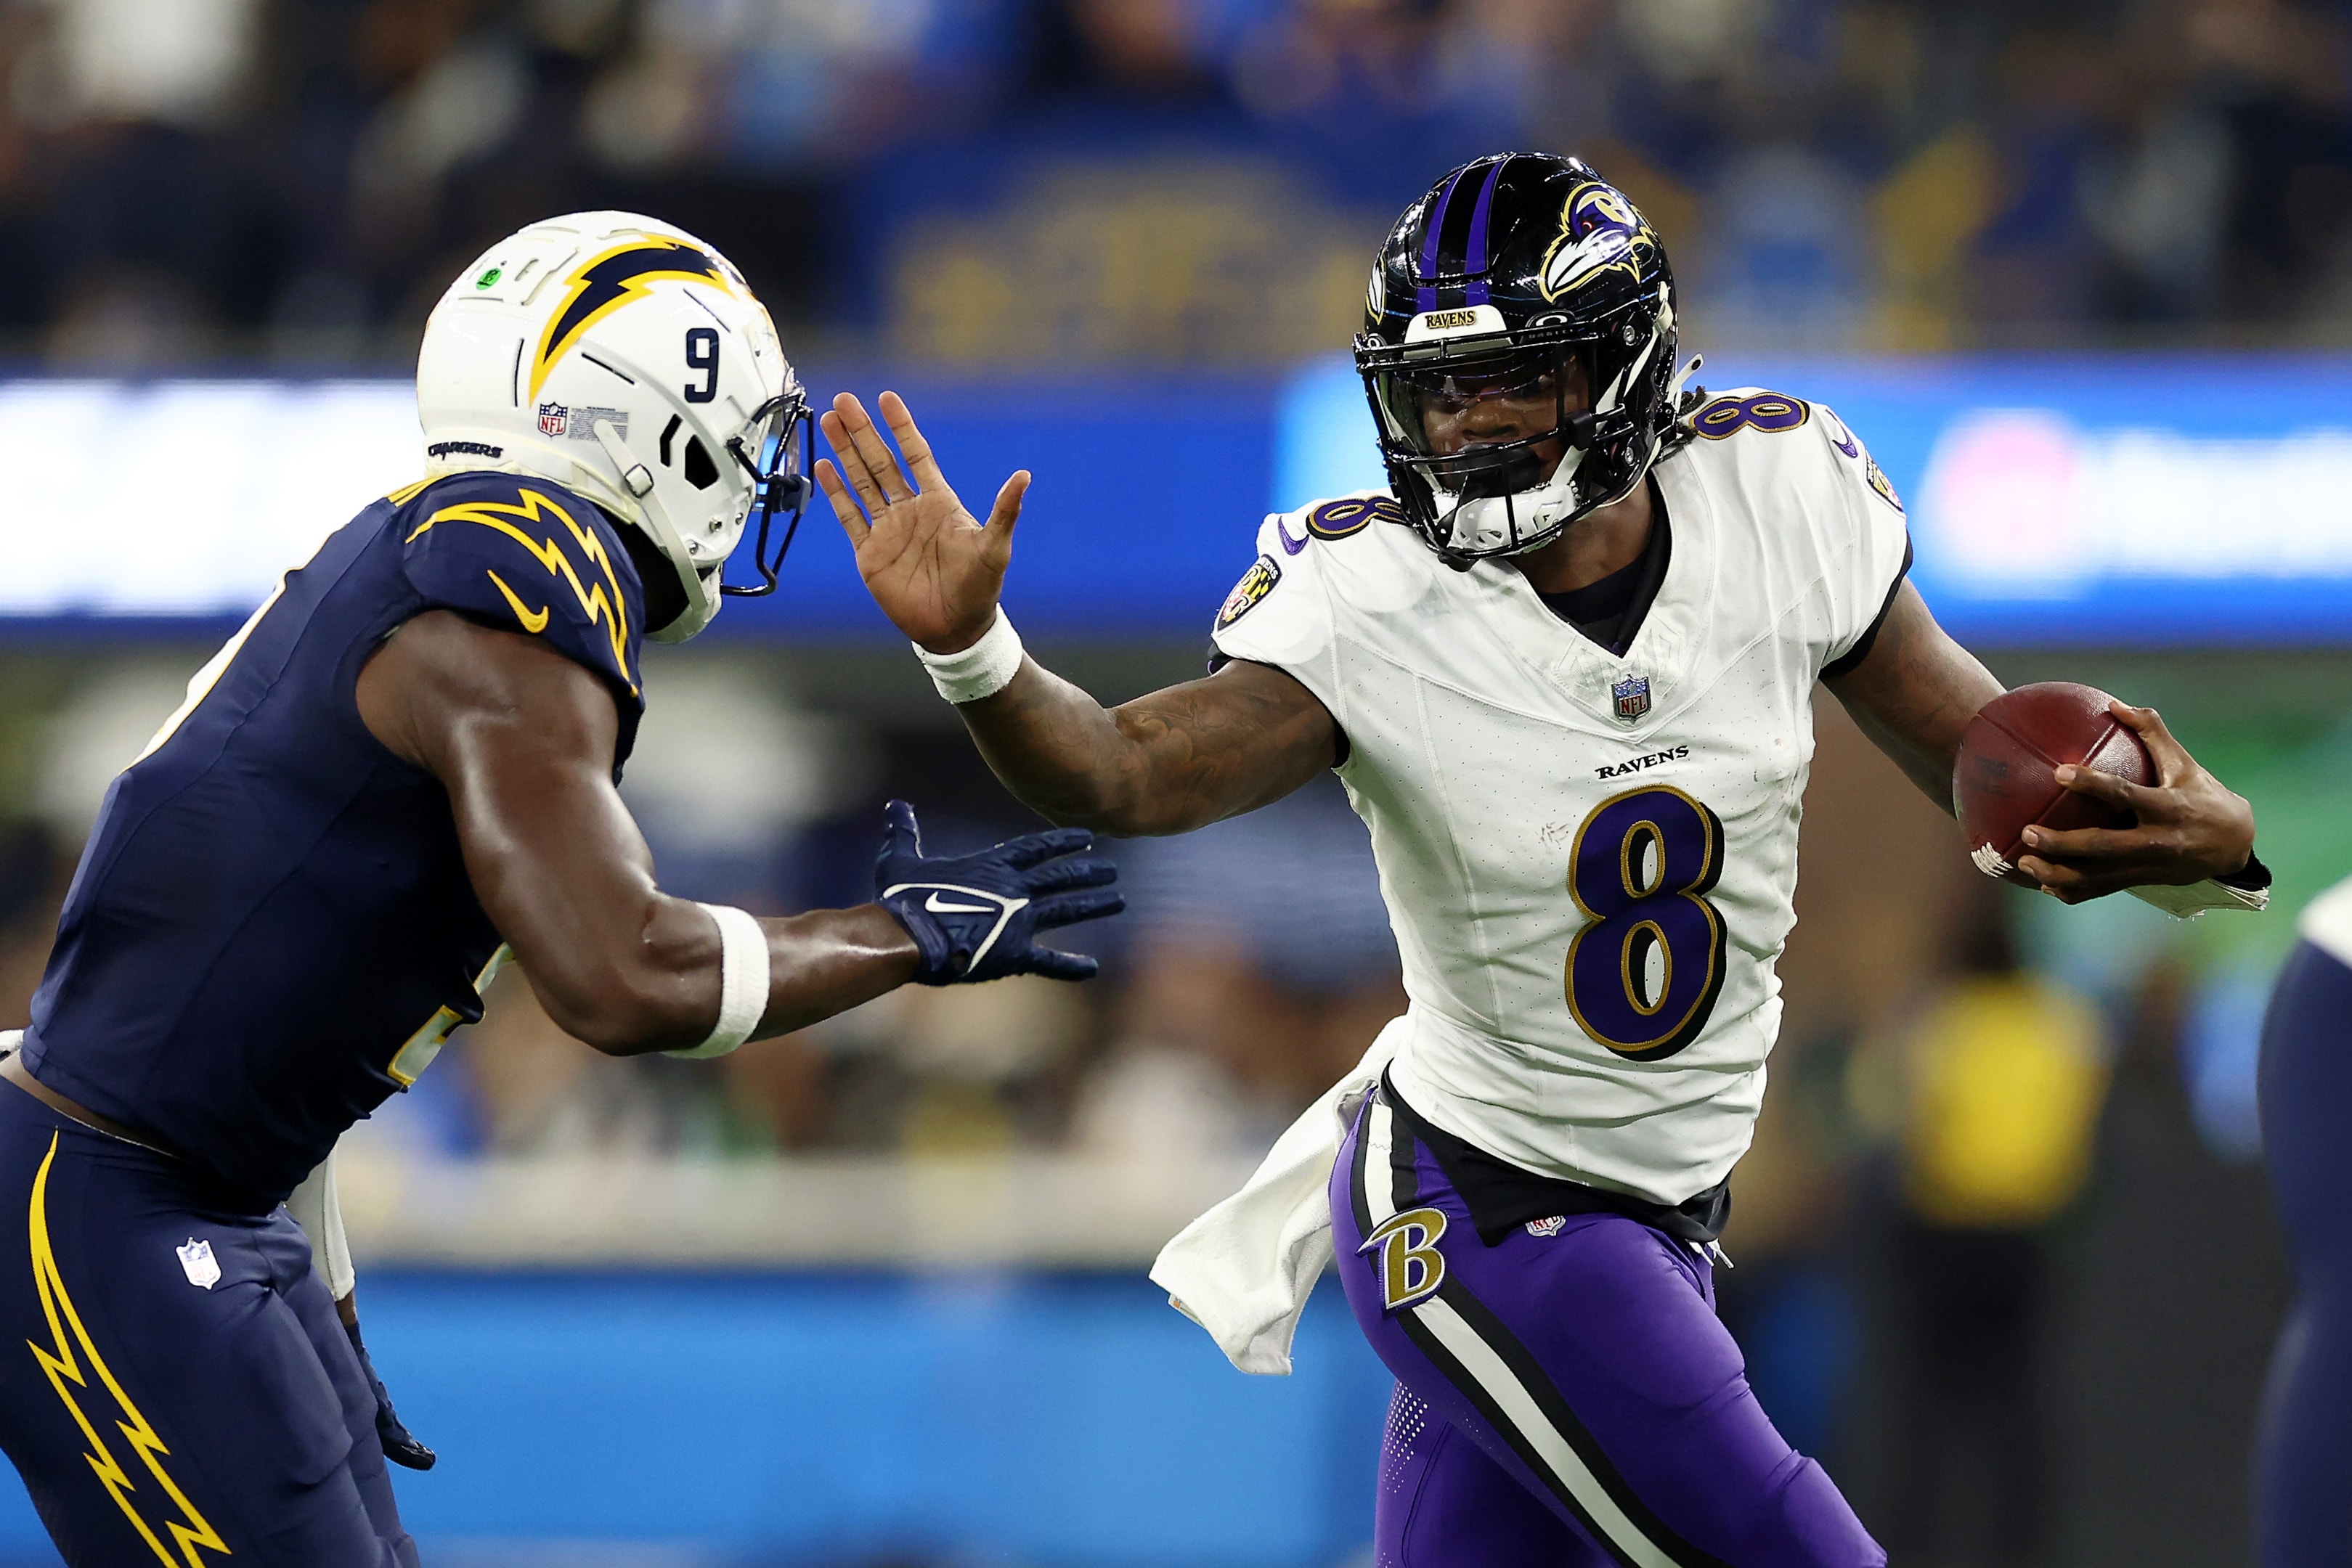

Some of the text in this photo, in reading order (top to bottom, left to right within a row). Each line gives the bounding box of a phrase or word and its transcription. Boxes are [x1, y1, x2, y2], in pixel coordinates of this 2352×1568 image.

[1425, 310, 1476, 330] RAVENS
[684, 327, 719, 404] 9
[540, 416, 563, 433] NFL
[1689, 391, 1810, 441] 8
[428, 441, 504, 461] CHARGERS
[1305, 494, 1412, 542] 8
[1619, 694, 1648, 714] NFL
[1594, 744, 1690, 780] RAVENS
[1564, 783, 1728, 1062] 8
[1354, 1205, 1449, 1310] B
